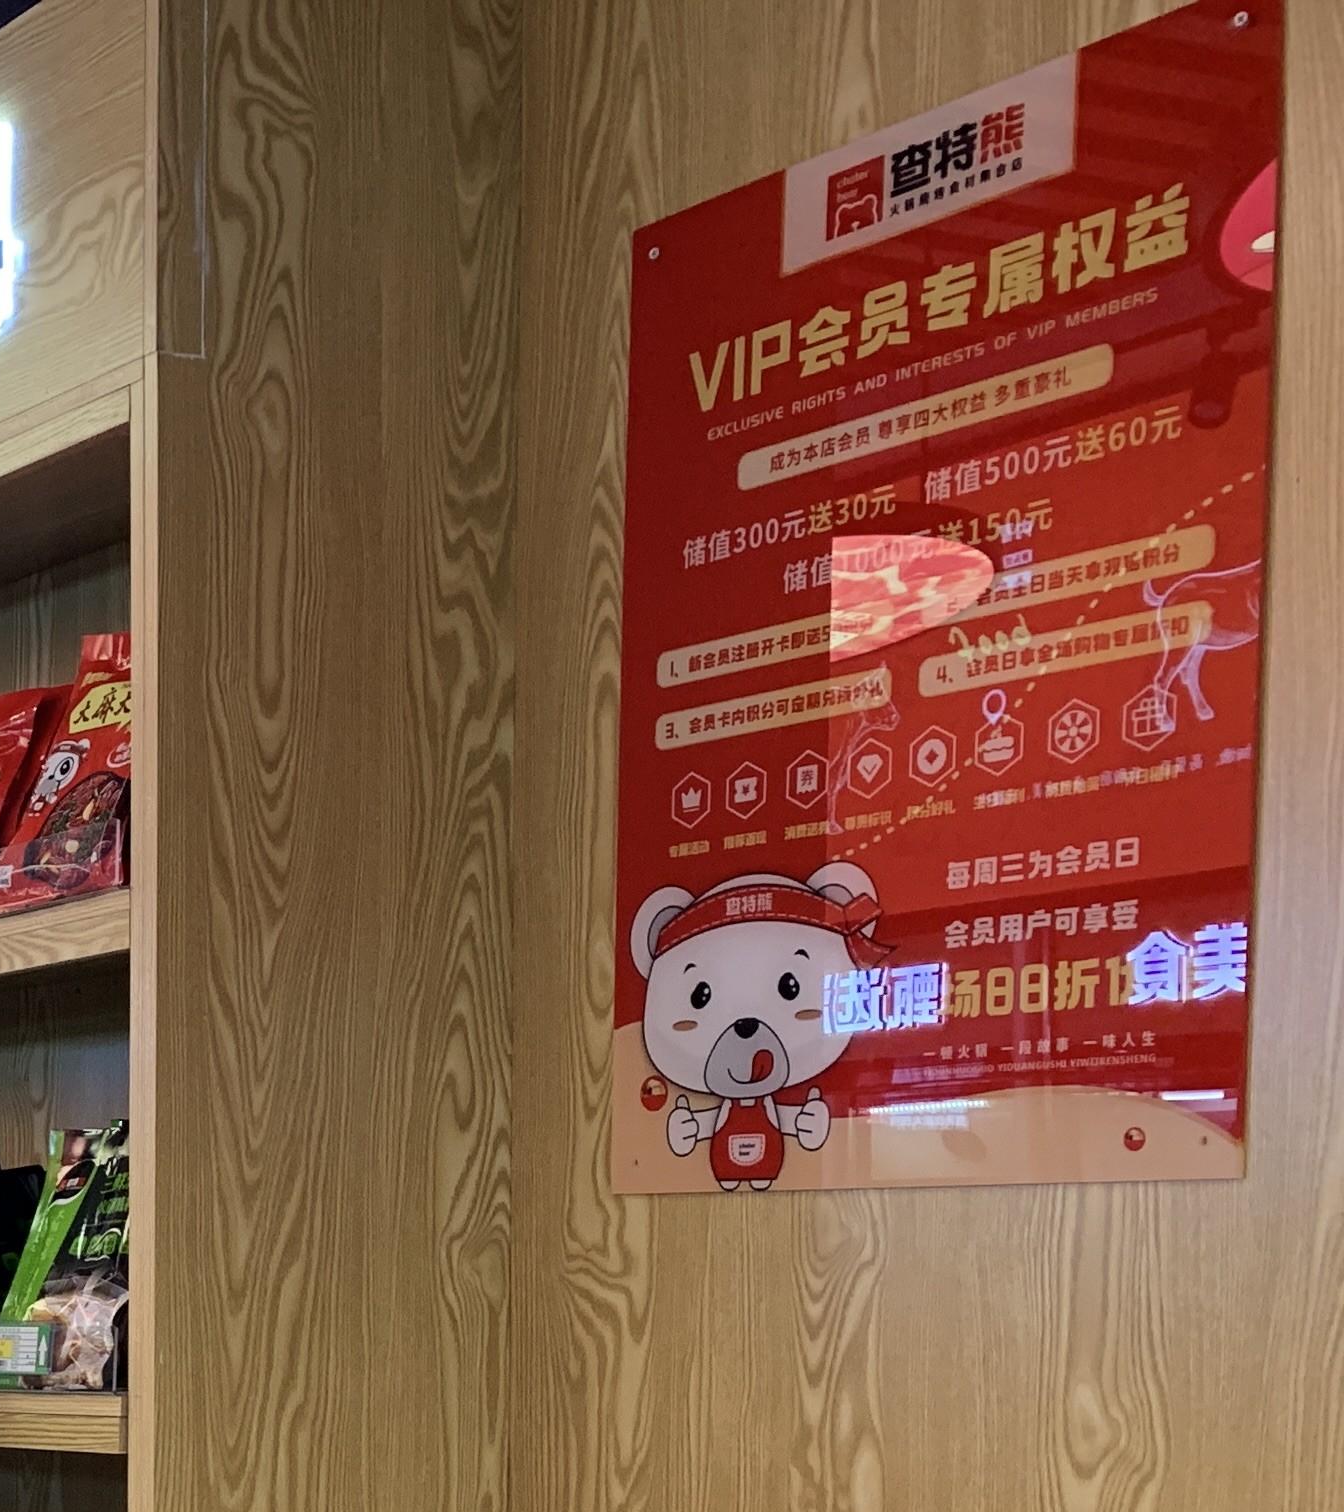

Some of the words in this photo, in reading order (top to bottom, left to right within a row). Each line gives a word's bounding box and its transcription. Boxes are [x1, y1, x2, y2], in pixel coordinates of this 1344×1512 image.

[890, 102, 1025, 198] 查特熊
[688, 182, 1192, 413] VIP会员专属权益
[706, 405, 785, 442] EXCLUSIVE
[791, 387, 847, 418] RIGHTS
[853, 375, 888, 397] AND
[894, 343, 986, 384] INTERESTS
[993, 333, 1018, 352] OF
[1026, 318, 1056, 341] VIP
[1064, 287, 1160, 329] MEMBERS
[768, 425, 871, 475] 成为本店会员
[876, 390, 988, 448] 尊享四大权益
[993, 365, 1073, 409] 多重豪礼
[923, 405, 1184, 506] 储值500元送60元
[682, 484, 898, 571] 储值300元送30元
[945, 836, 1140, 891] 每周三为会员日
[943, 898, 1140, 950] 会员用户可享受
